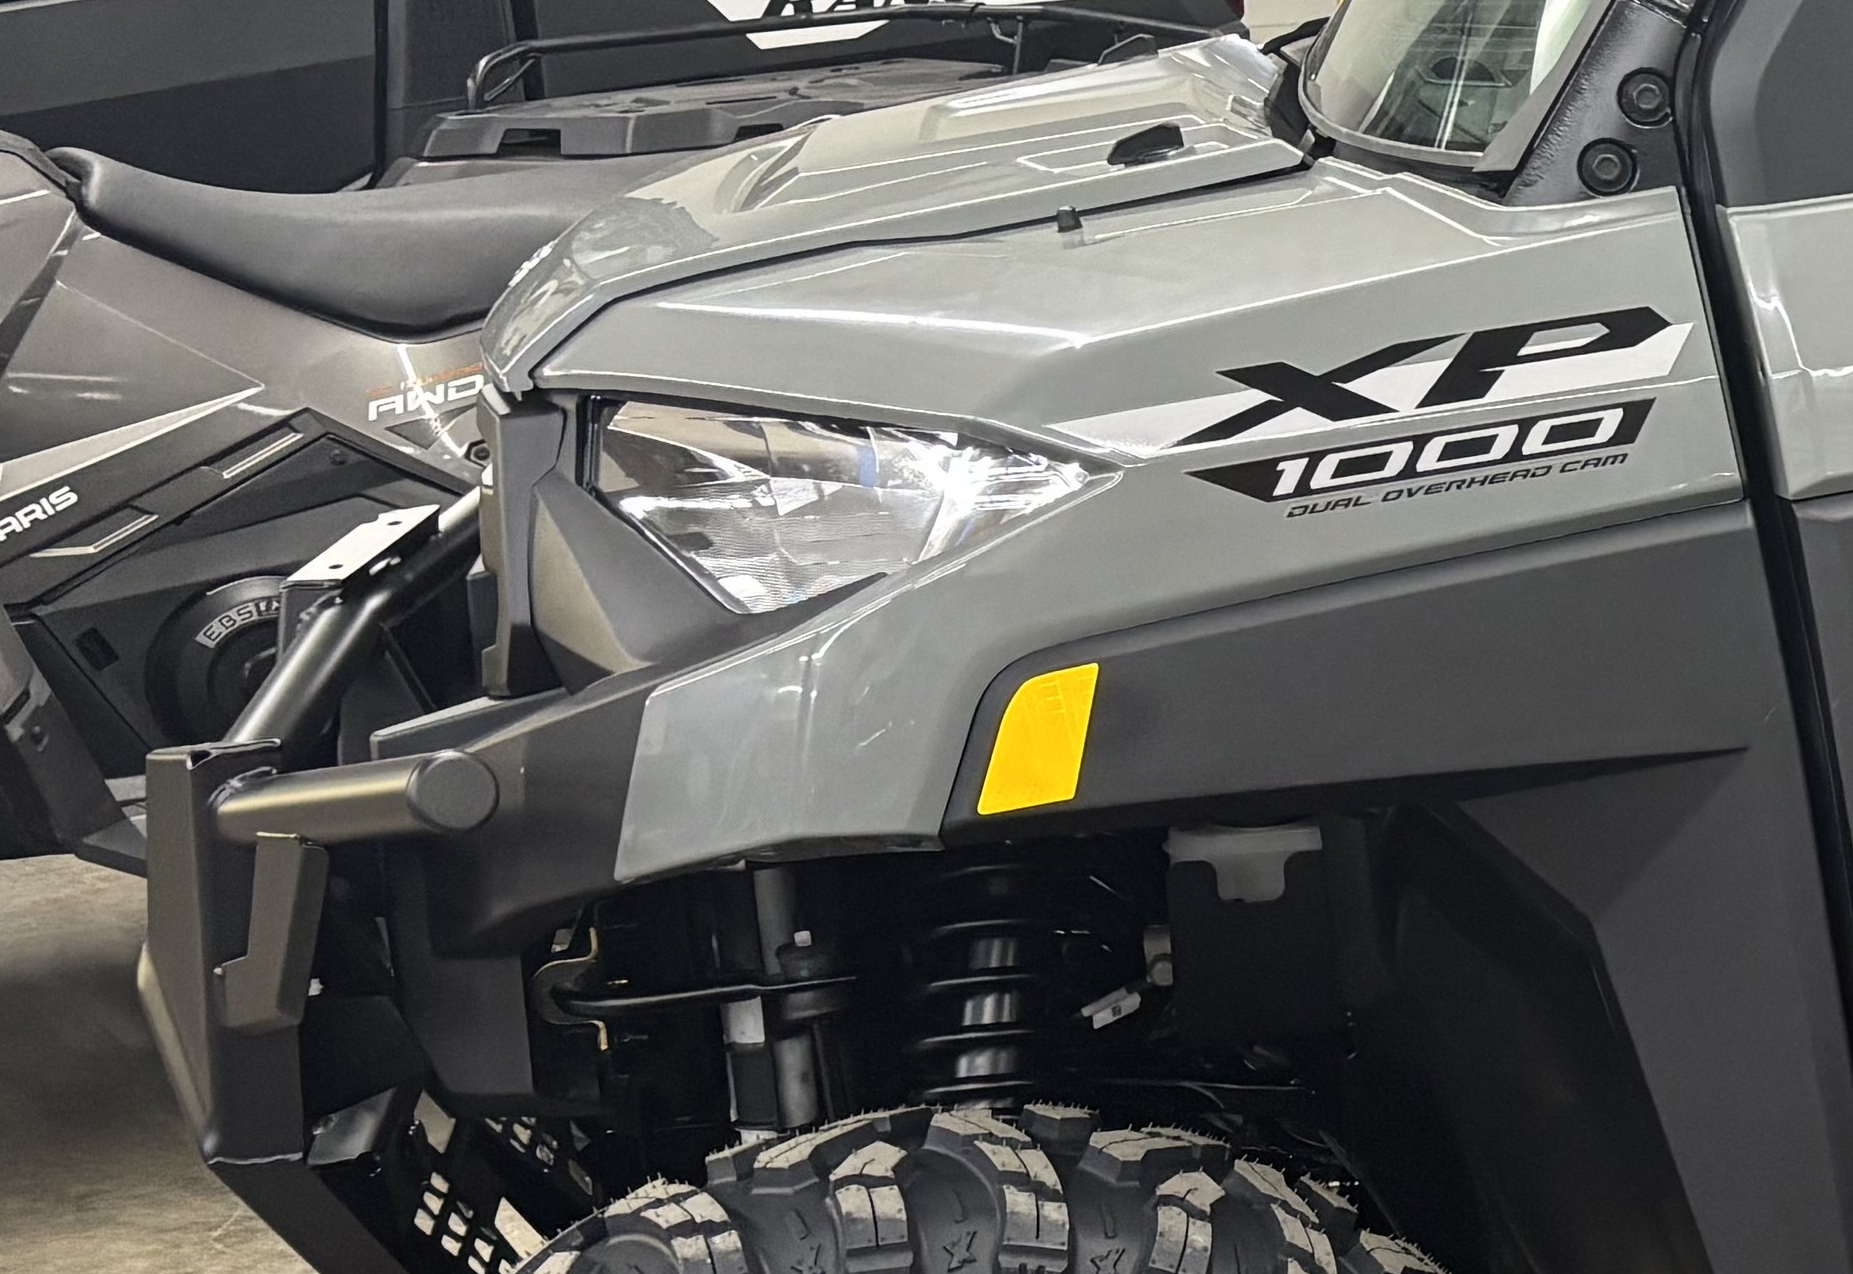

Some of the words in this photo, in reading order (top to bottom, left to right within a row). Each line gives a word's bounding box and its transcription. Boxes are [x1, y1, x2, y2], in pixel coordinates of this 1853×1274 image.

[367, 373, 485, 422] AWD
[1163, 306, 1675, 449] XP
[1272, 407, 1625, 497] 1000
[1285, 494, 1373, 519] DUAL
[1381, 465, 1554, 502] OVERHEAD
[1558, 452, 1630, 474] CAM
[203, 605, 254, 642] EBS
